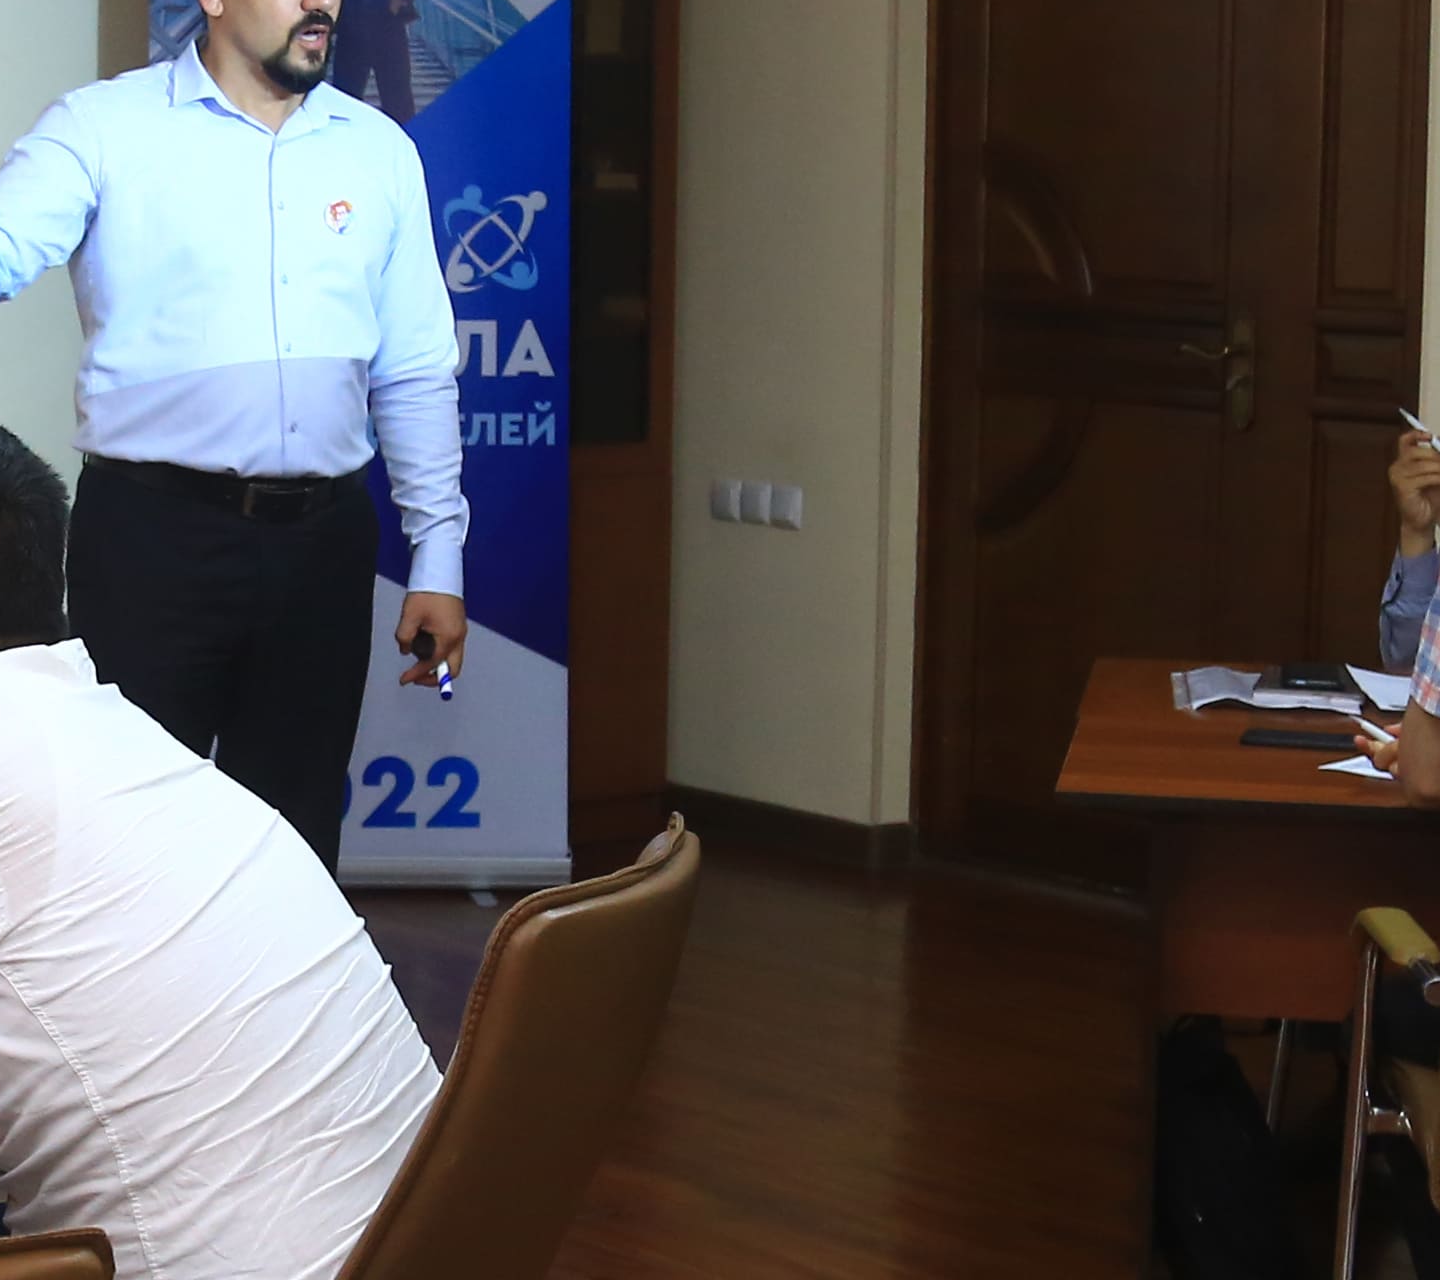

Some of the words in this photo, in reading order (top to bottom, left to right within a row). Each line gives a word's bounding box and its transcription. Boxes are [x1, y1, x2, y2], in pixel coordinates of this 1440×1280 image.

[454, 319, 555, 377] ЛА
[457, 400, 556, 446] ЛЕЙ
[341, 755, 481, 828] 22
